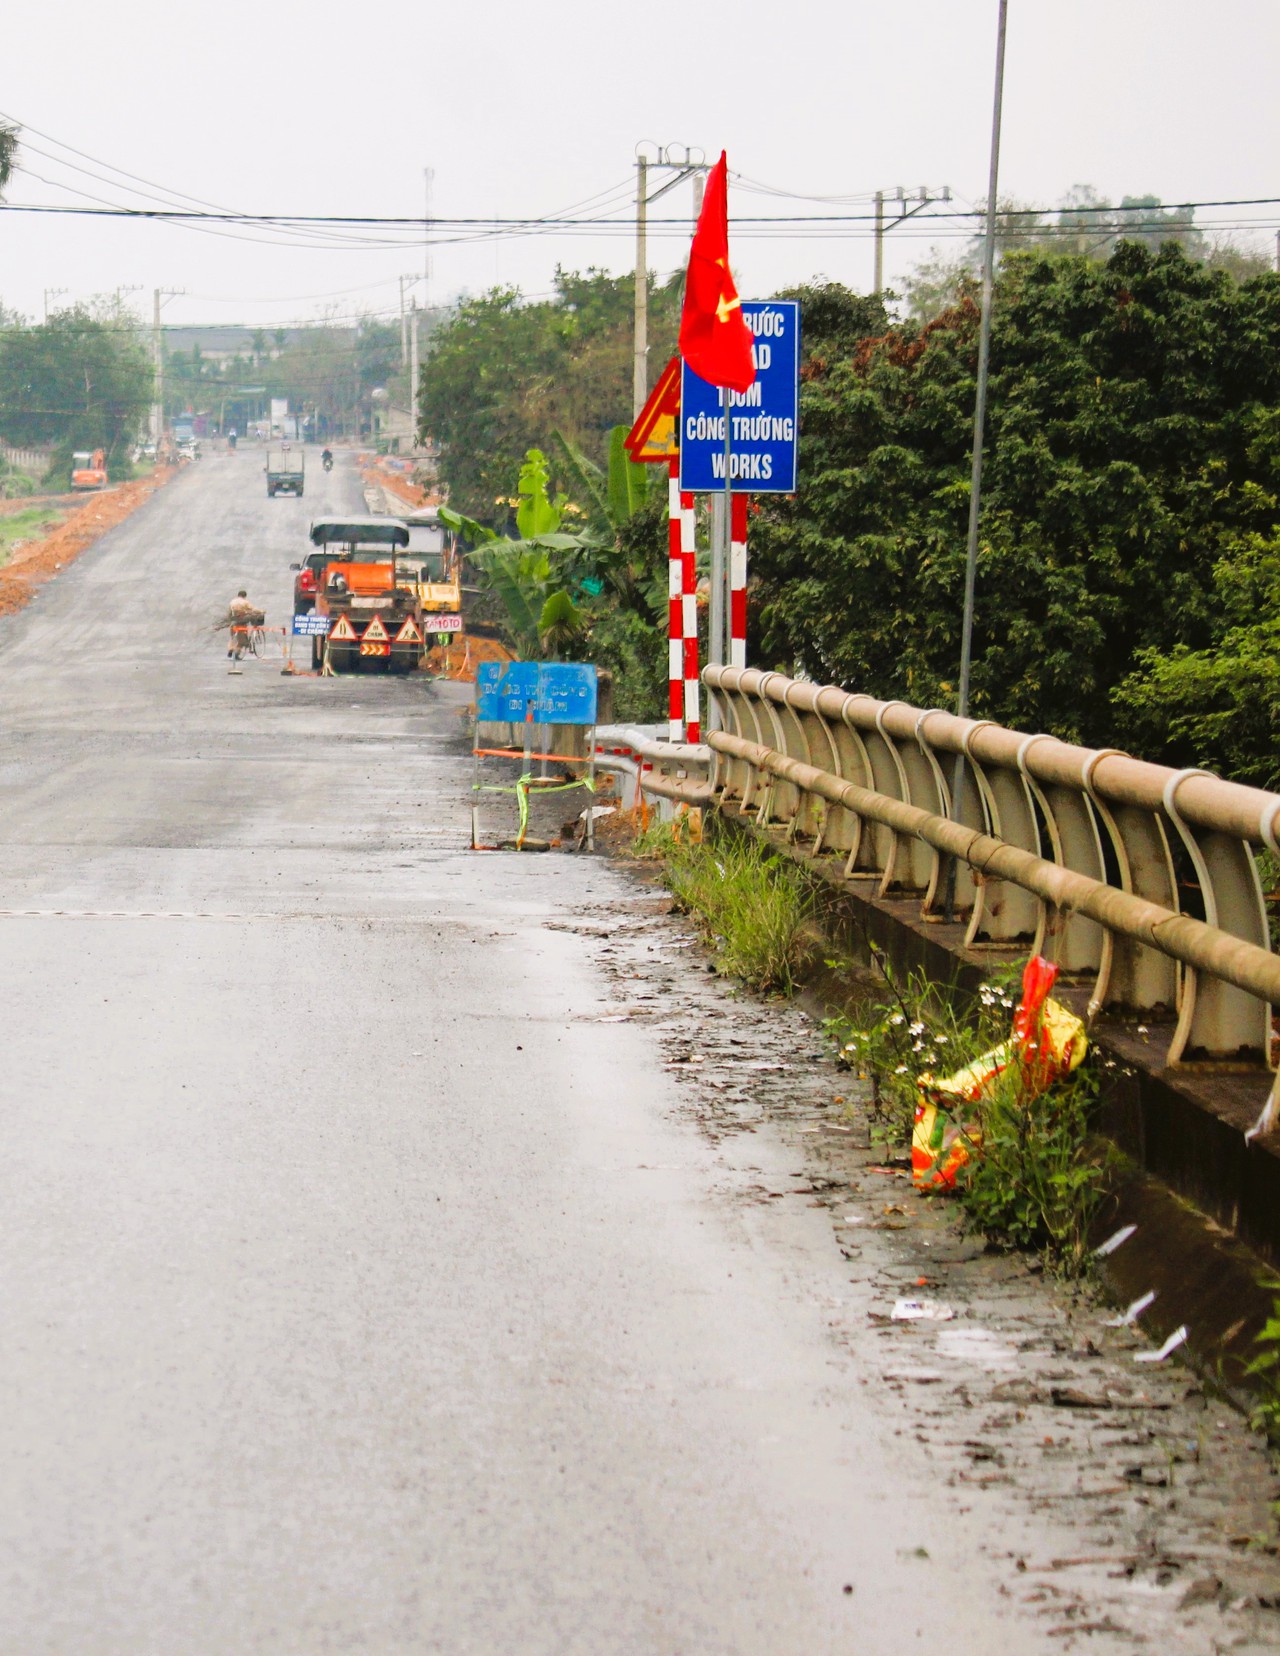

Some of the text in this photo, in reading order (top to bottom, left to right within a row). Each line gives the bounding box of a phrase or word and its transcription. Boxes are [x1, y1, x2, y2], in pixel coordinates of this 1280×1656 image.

[686, 410, 793, 442] CÔNG TRƯỜNG
[712, 453, 772, 480] WORKS
